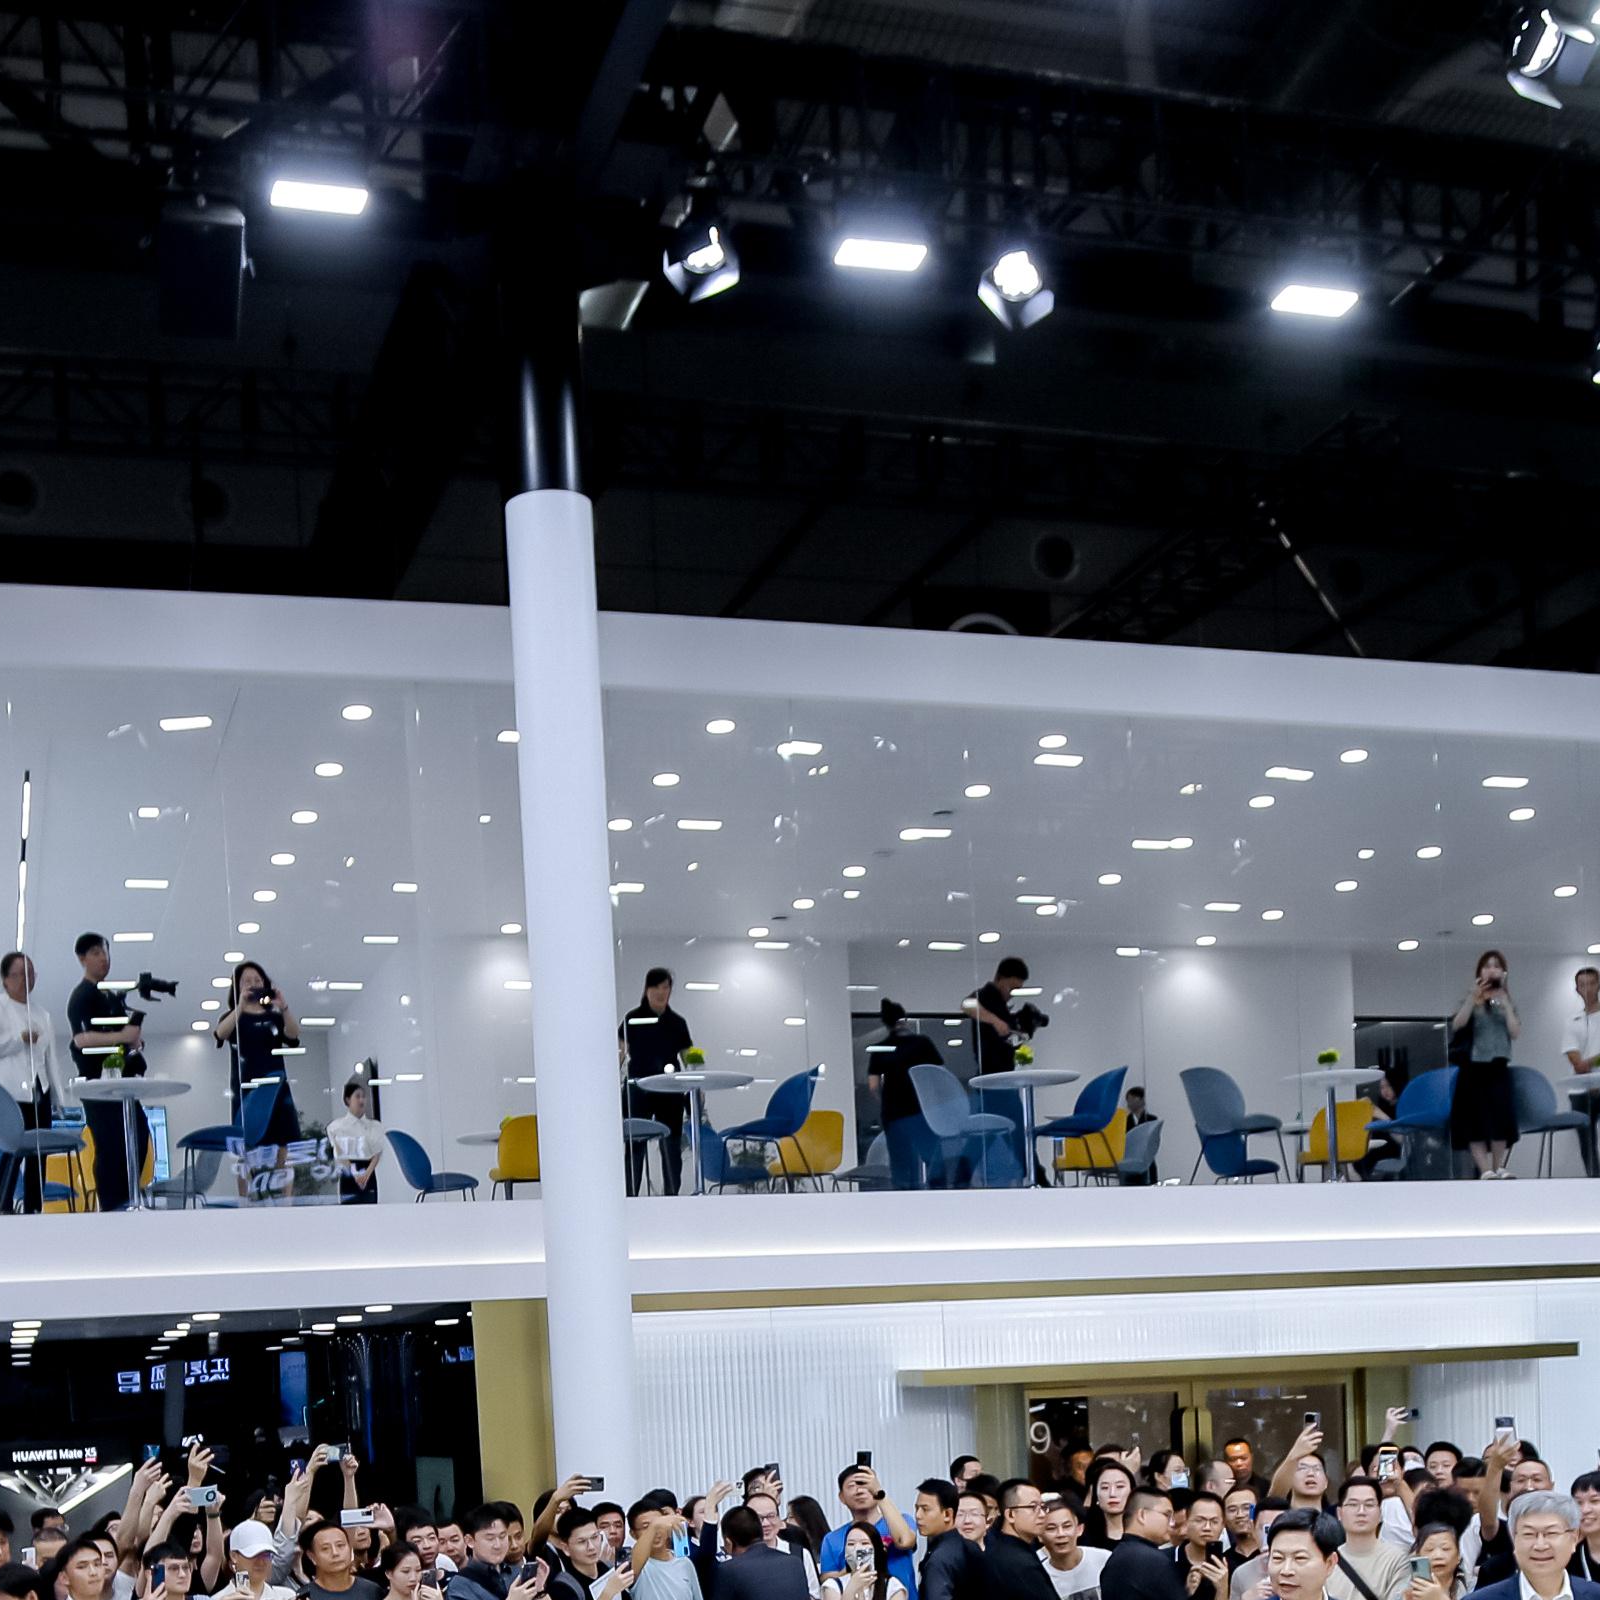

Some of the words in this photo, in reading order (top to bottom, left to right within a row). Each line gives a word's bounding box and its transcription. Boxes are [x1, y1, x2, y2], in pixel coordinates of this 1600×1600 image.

[12, 1449, 58, 1462] HUAWEI
[59, 1448, 83, 1459] Mate
[84, 1446, 97, 1457] X5
